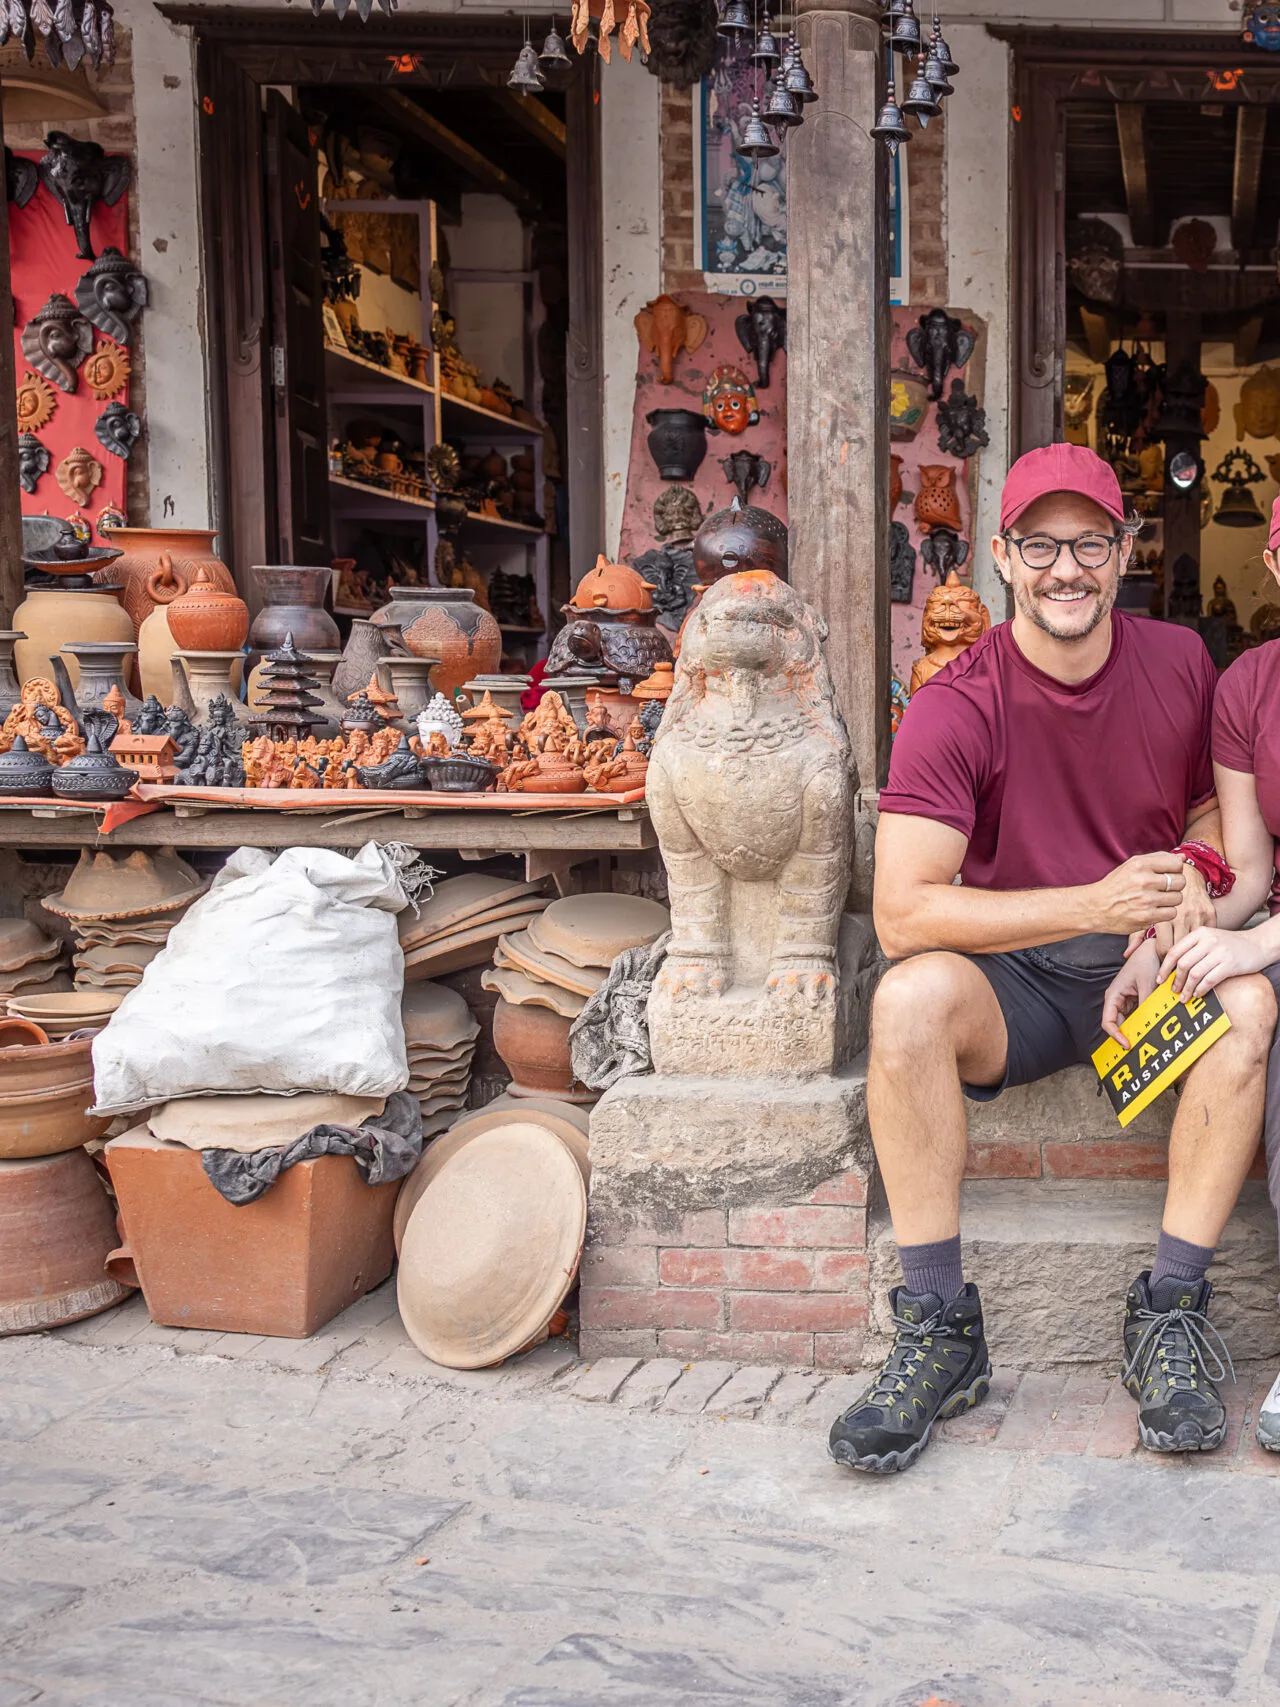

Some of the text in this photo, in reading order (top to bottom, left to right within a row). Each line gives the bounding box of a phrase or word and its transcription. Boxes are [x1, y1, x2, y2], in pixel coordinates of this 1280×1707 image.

[1111, 996, 1207, 1092] RACE
[1121, 1011, 1213, 1103] AUSTRALIA
[1136, 996, 1177, 1038] AMAZI
